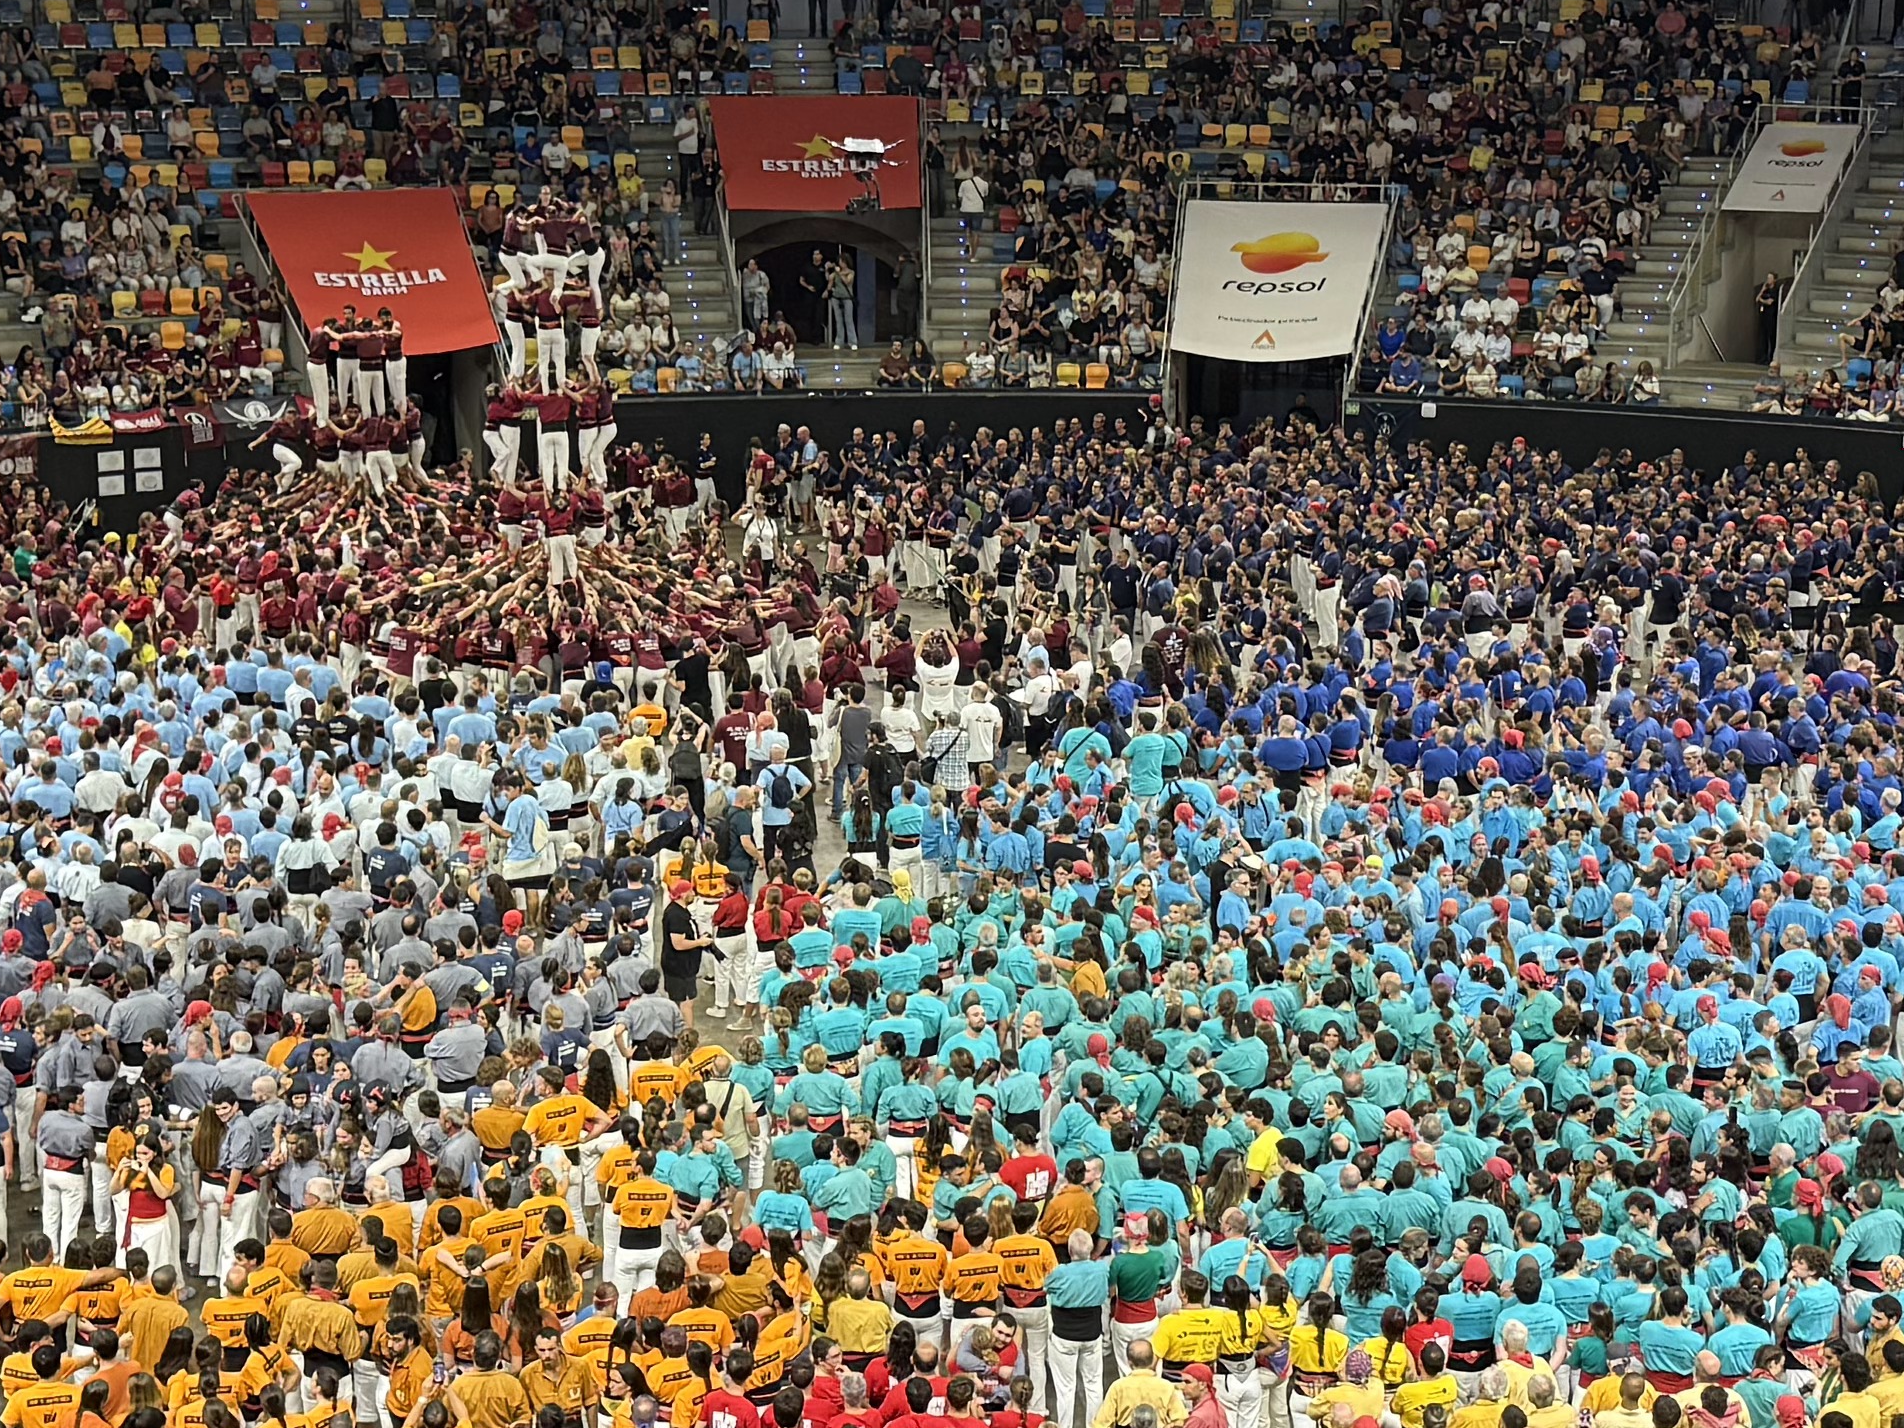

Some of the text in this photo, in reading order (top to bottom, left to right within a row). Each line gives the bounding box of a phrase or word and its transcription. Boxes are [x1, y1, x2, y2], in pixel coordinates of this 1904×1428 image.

[1767, 159, 1825, 168] repsol
[314, 269, 447, 288] ESTRELLA
[1222, 276, 1327, 296] repsol
[361, 285, 408, 296] DAMM
